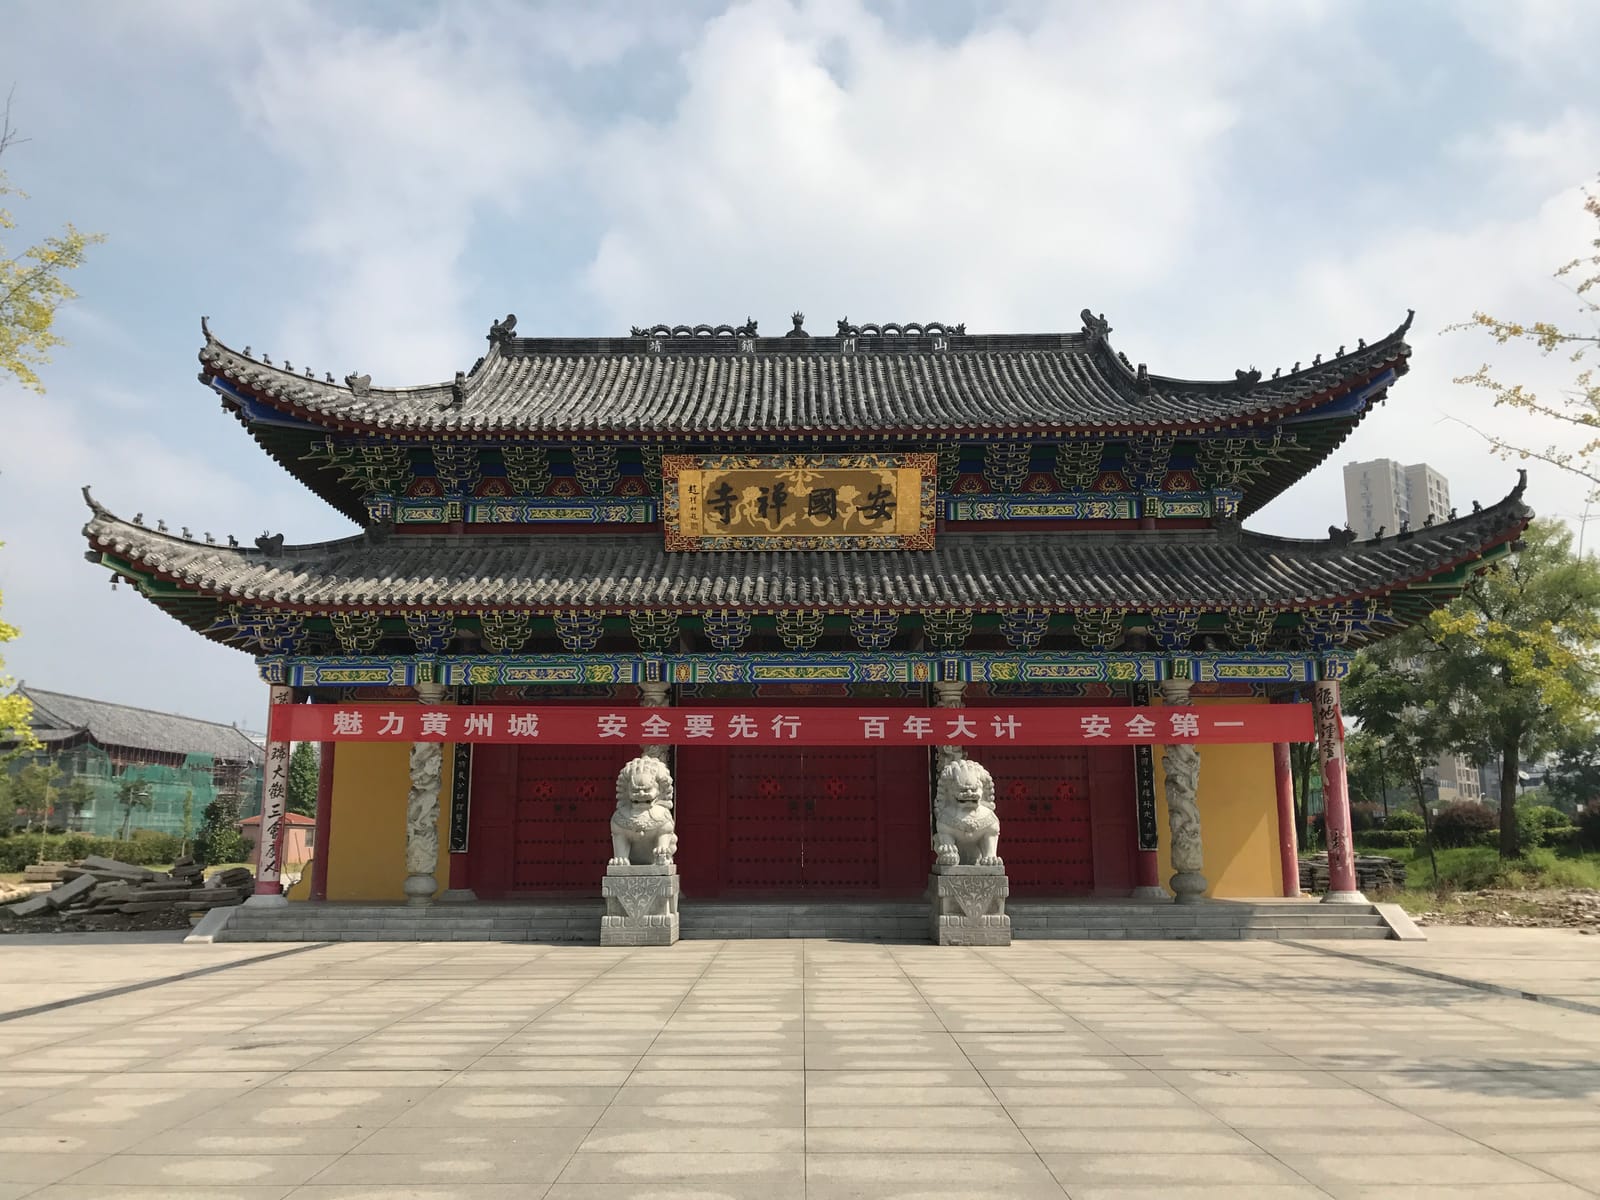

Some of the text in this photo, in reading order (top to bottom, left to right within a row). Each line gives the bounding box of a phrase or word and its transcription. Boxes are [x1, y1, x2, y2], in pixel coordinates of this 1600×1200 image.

[332, 711, 1244, 739] 魅力黄州城 安全要先行 百年大计 安全第一
